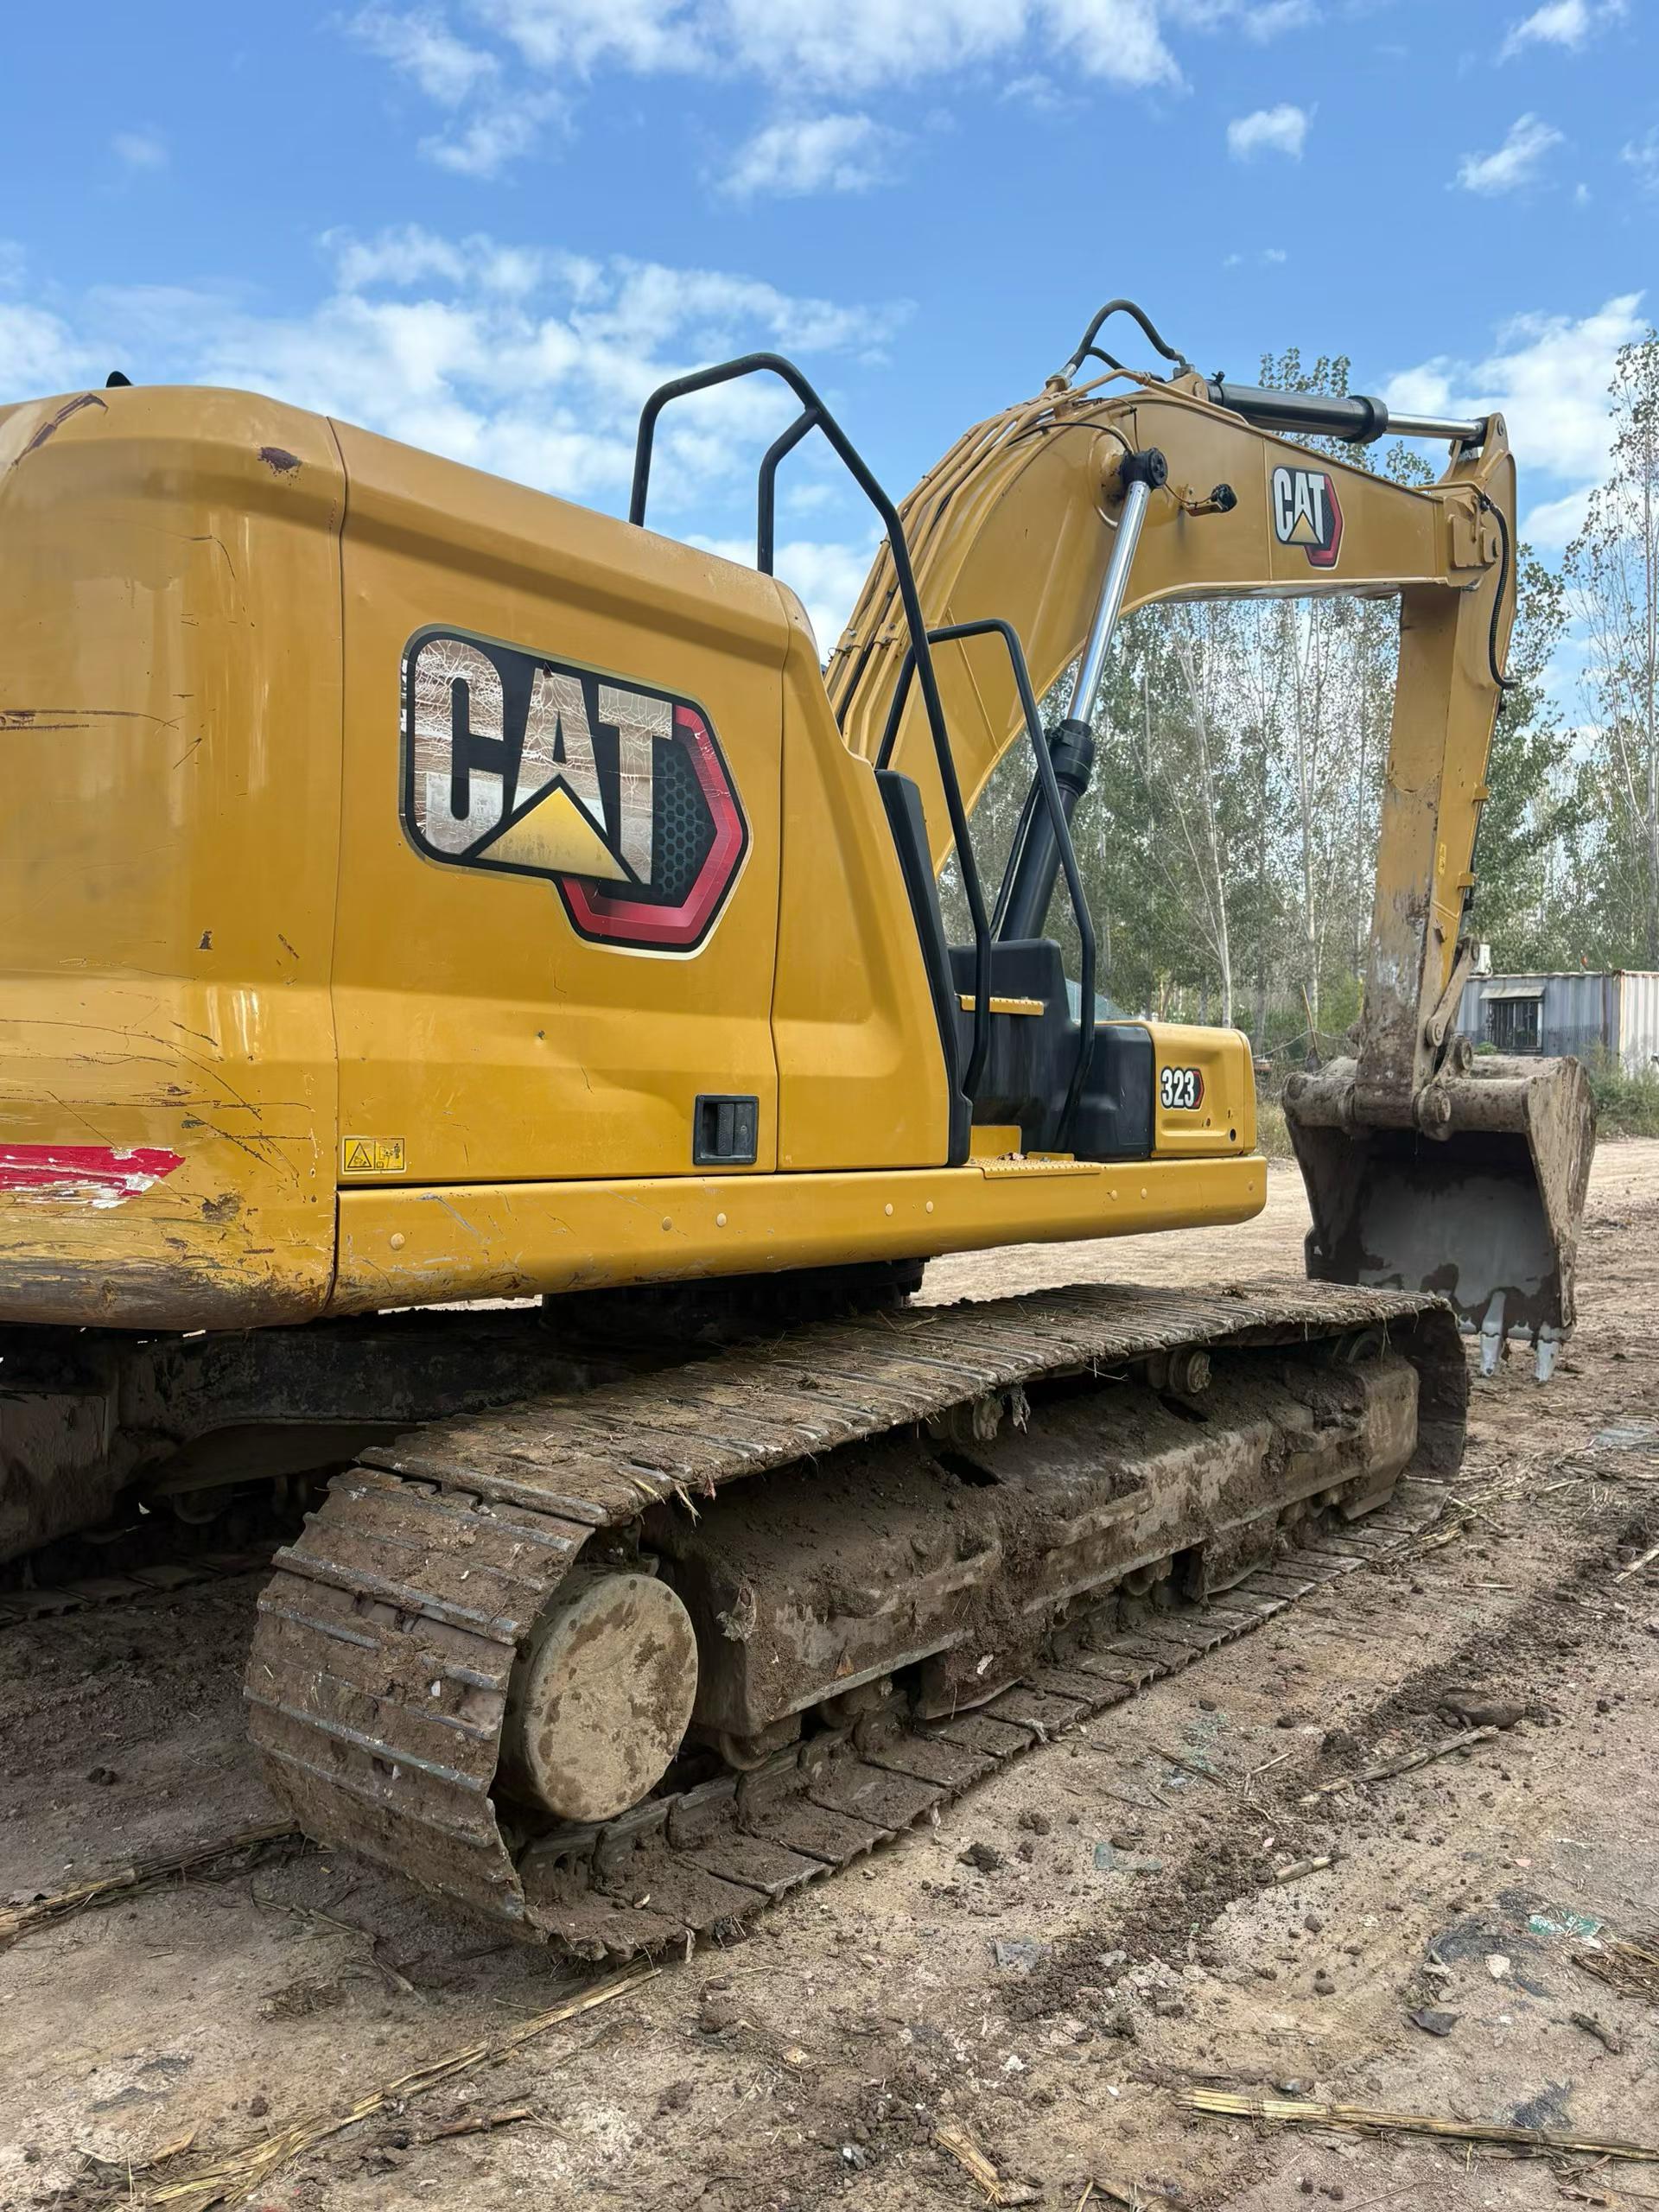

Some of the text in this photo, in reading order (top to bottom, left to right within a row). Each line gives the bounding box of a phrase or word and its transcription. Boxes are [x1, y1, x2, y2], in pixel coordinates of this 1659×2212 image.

[1274, 467, 1325, 544] CAT
[413, 639, 672, 886] CAT
[1161, 1068, 1195, 1107] 323
